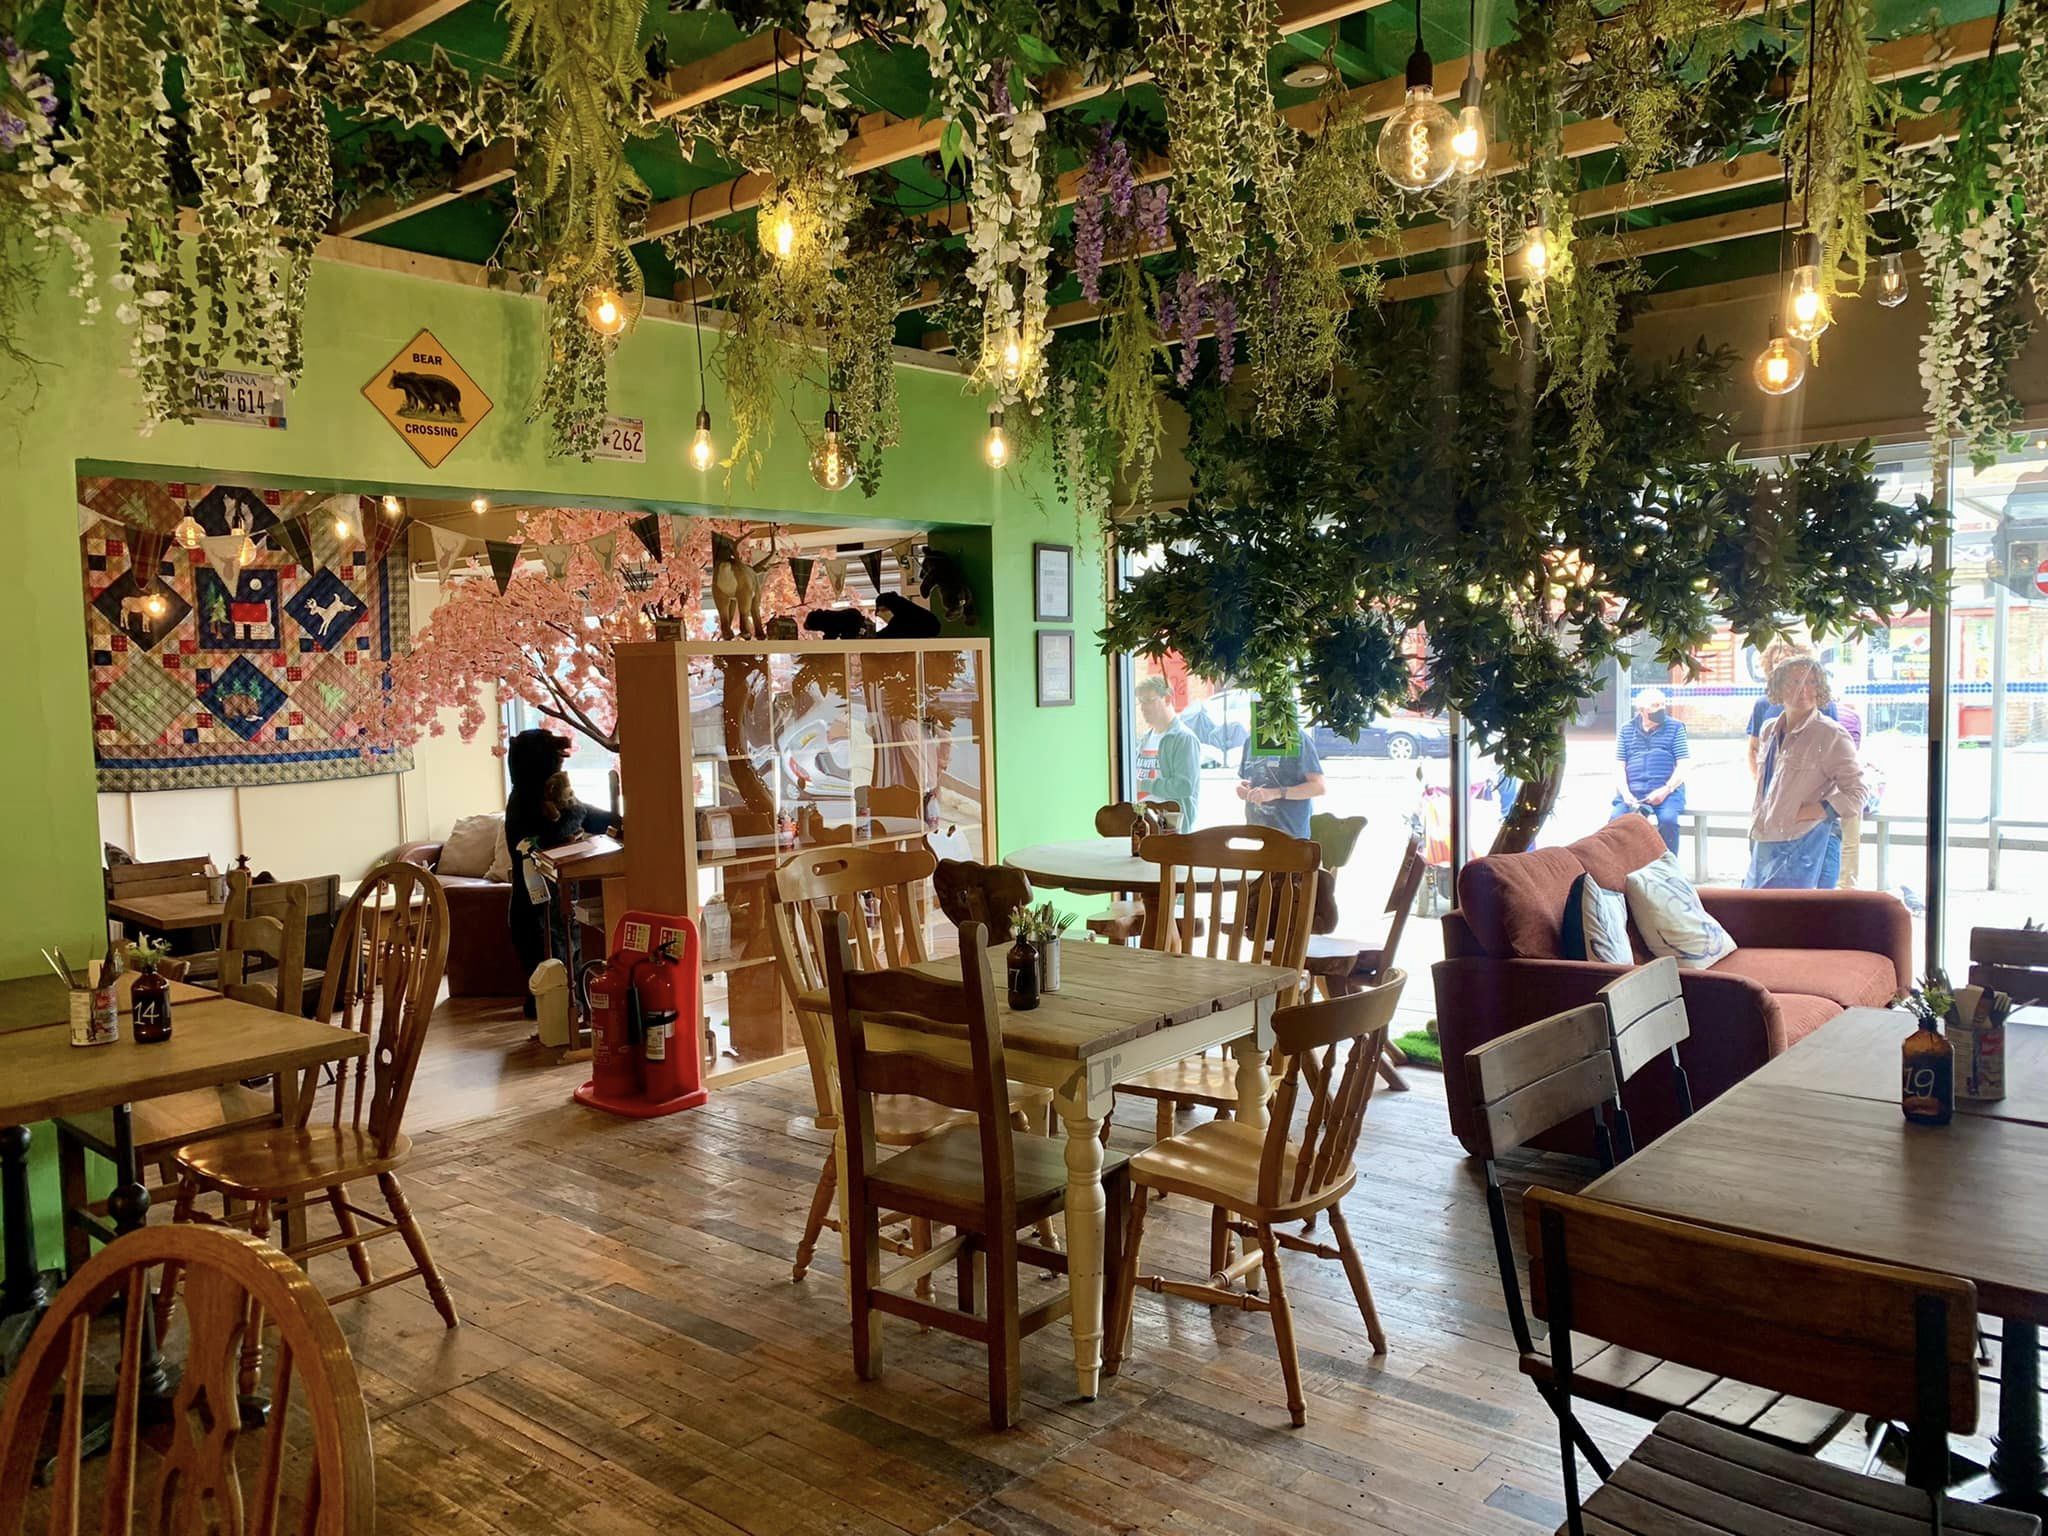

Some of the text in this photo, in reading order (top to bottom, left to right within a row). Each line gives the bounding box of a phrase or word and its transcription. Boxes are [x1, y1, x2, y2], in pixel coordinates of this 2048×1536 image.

[412, 353, 442, 365] BEAR
[405, 423, 458, 437] CROSSING
[134, 1000, 159, 1025] 14
[1903, 1066, 1935, 1099] 19
